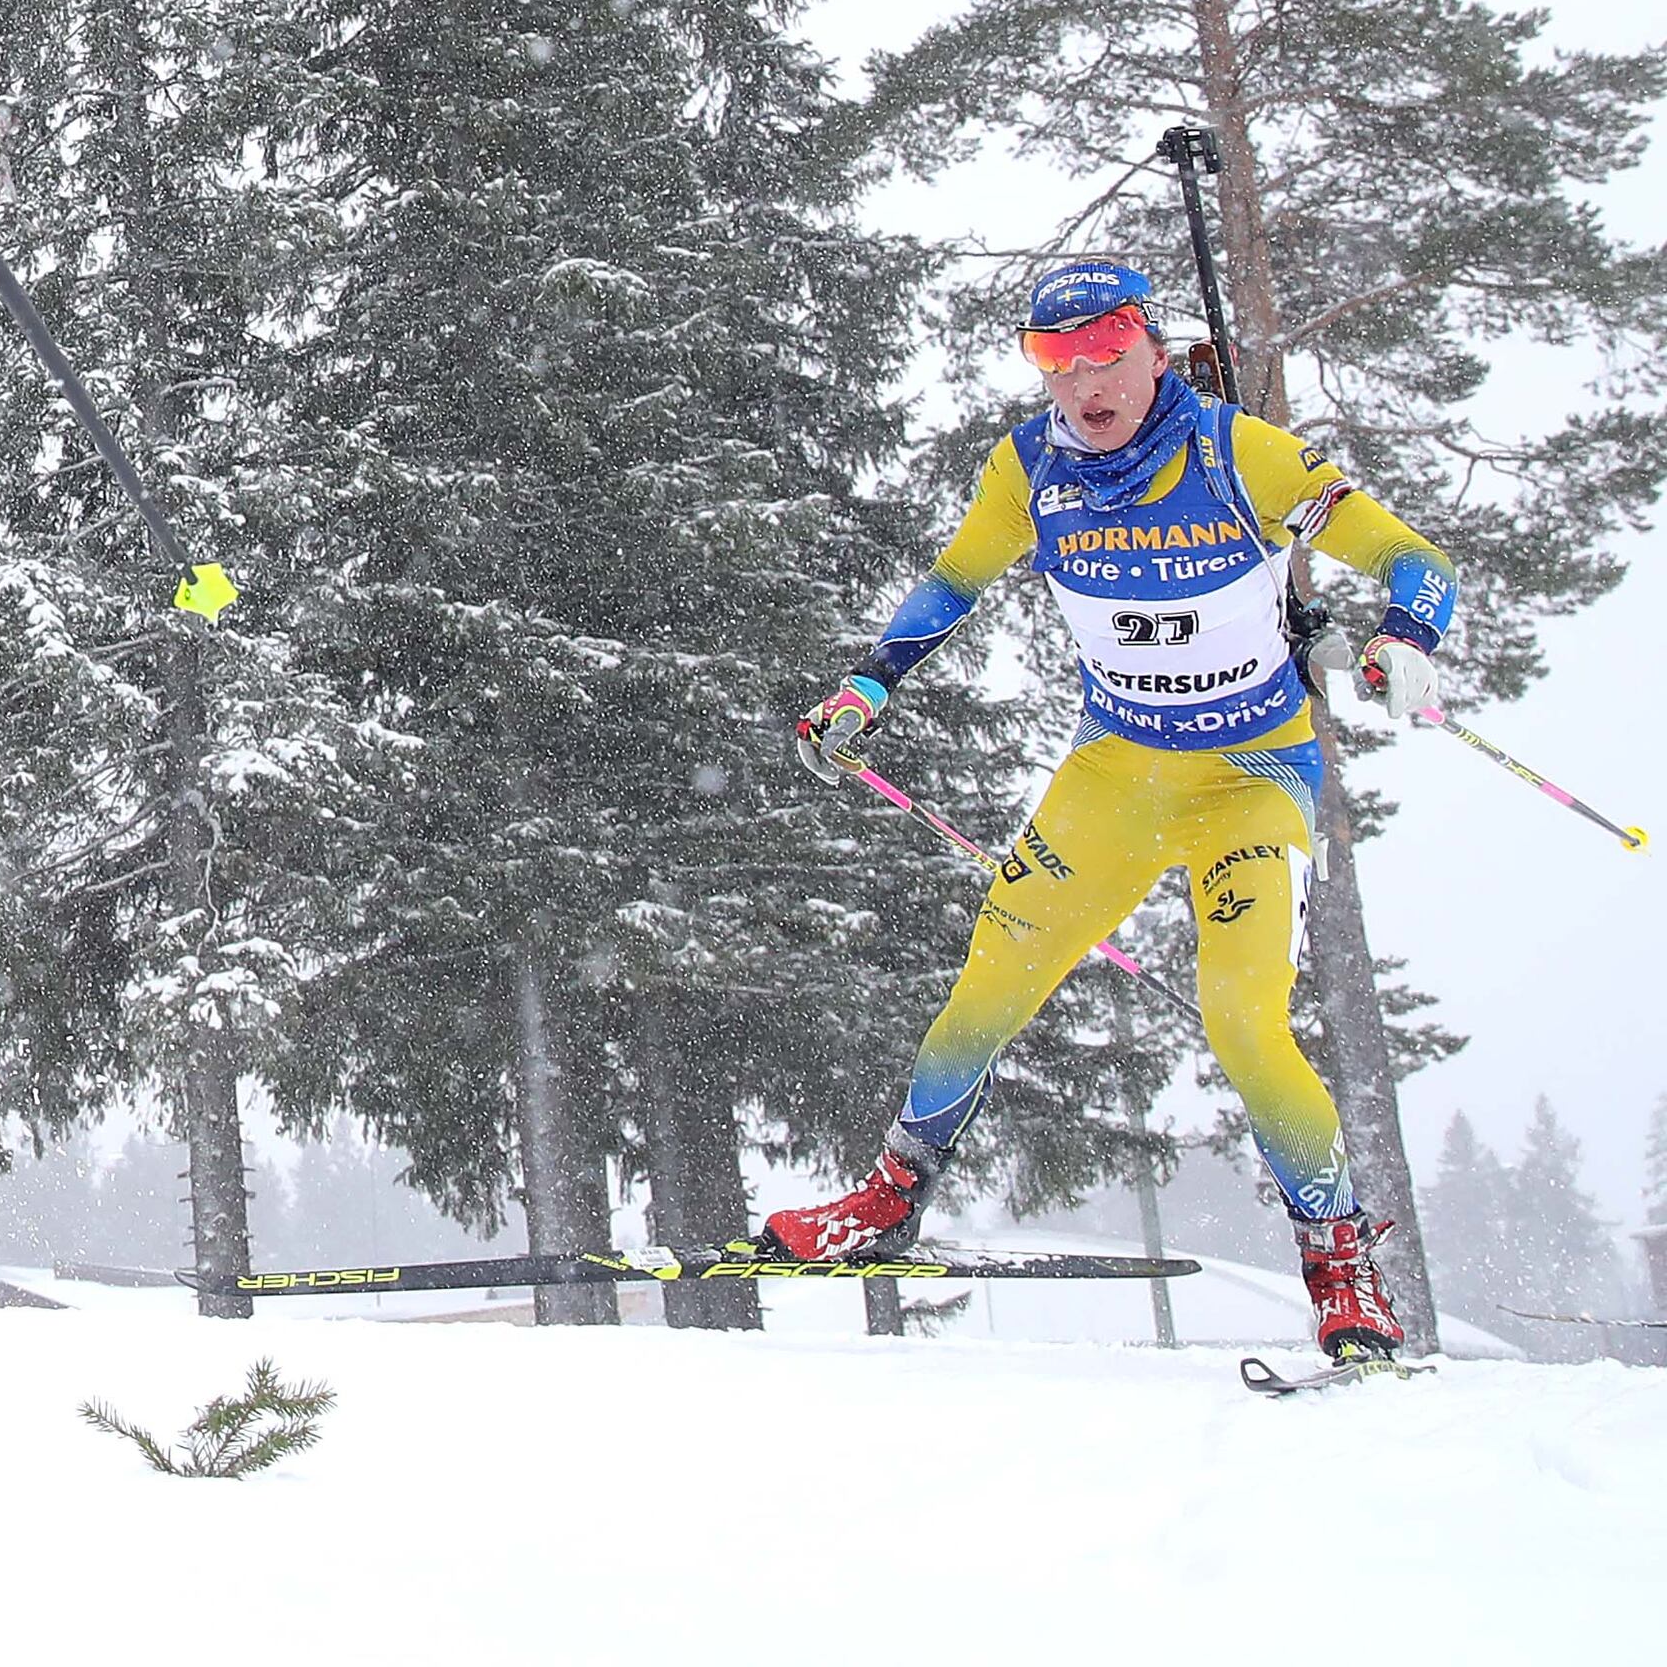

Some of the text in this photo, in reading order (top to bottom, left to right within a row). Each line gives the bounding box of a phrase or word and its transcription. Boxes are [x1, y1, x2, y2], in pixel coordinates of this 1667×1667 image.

[1199, 434, 1217, 469] ATG
[1411, 570, 1449, 620] SWE
[1023, 819, 1076, 880] STADS
[237, 1267, 401, 1290] FISCHER
